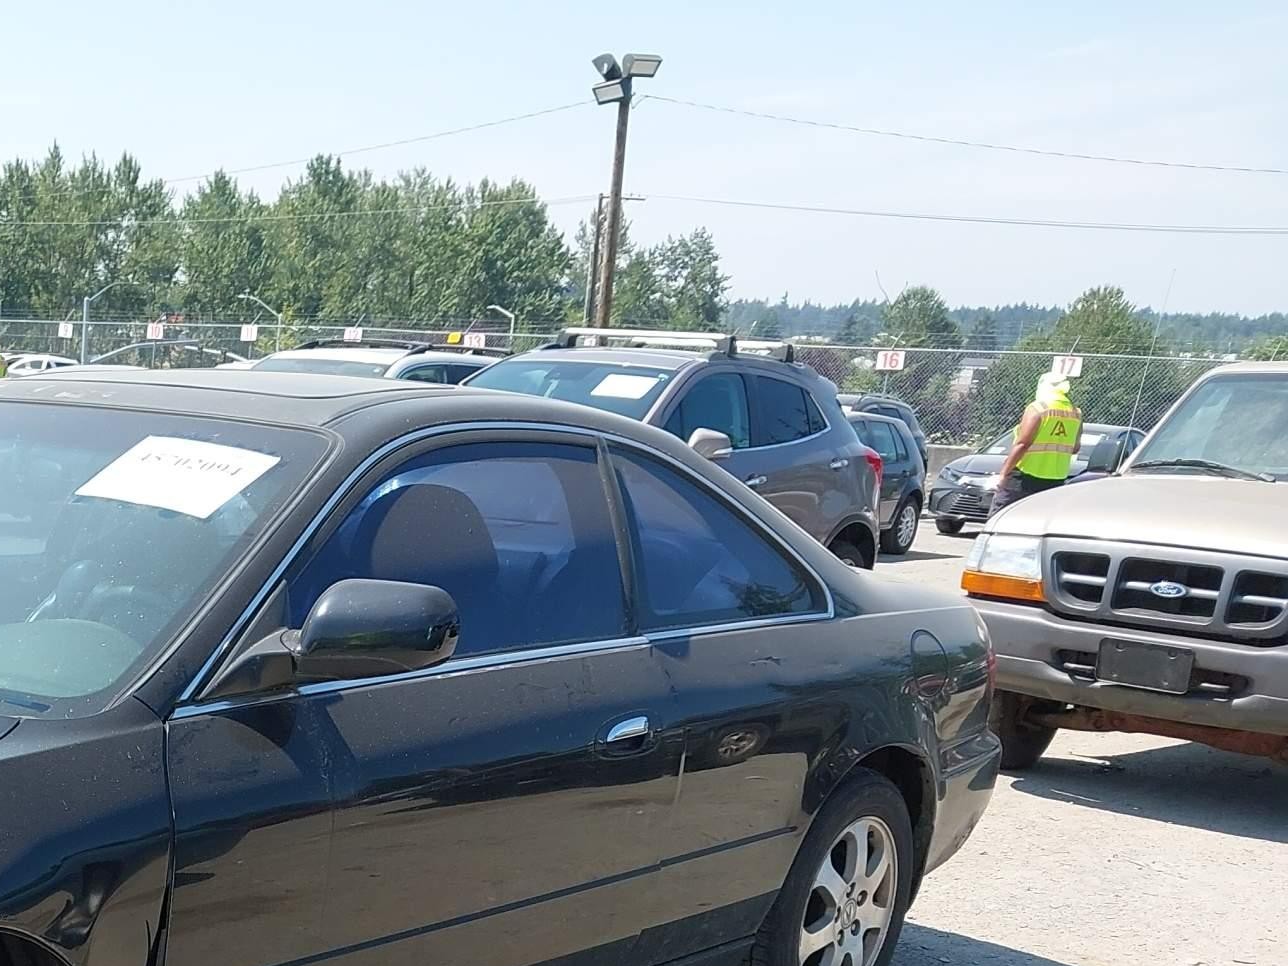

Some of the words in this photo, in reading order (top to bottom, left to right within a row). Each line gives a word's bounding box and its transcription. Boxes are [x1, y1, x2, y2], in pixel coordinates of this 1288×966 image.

[151, 325, 161, 338] 10
[468, 335, 482, 348] 13
[882, 352, 900, 369] 16
[1060, 357, 1077, 375] 17
